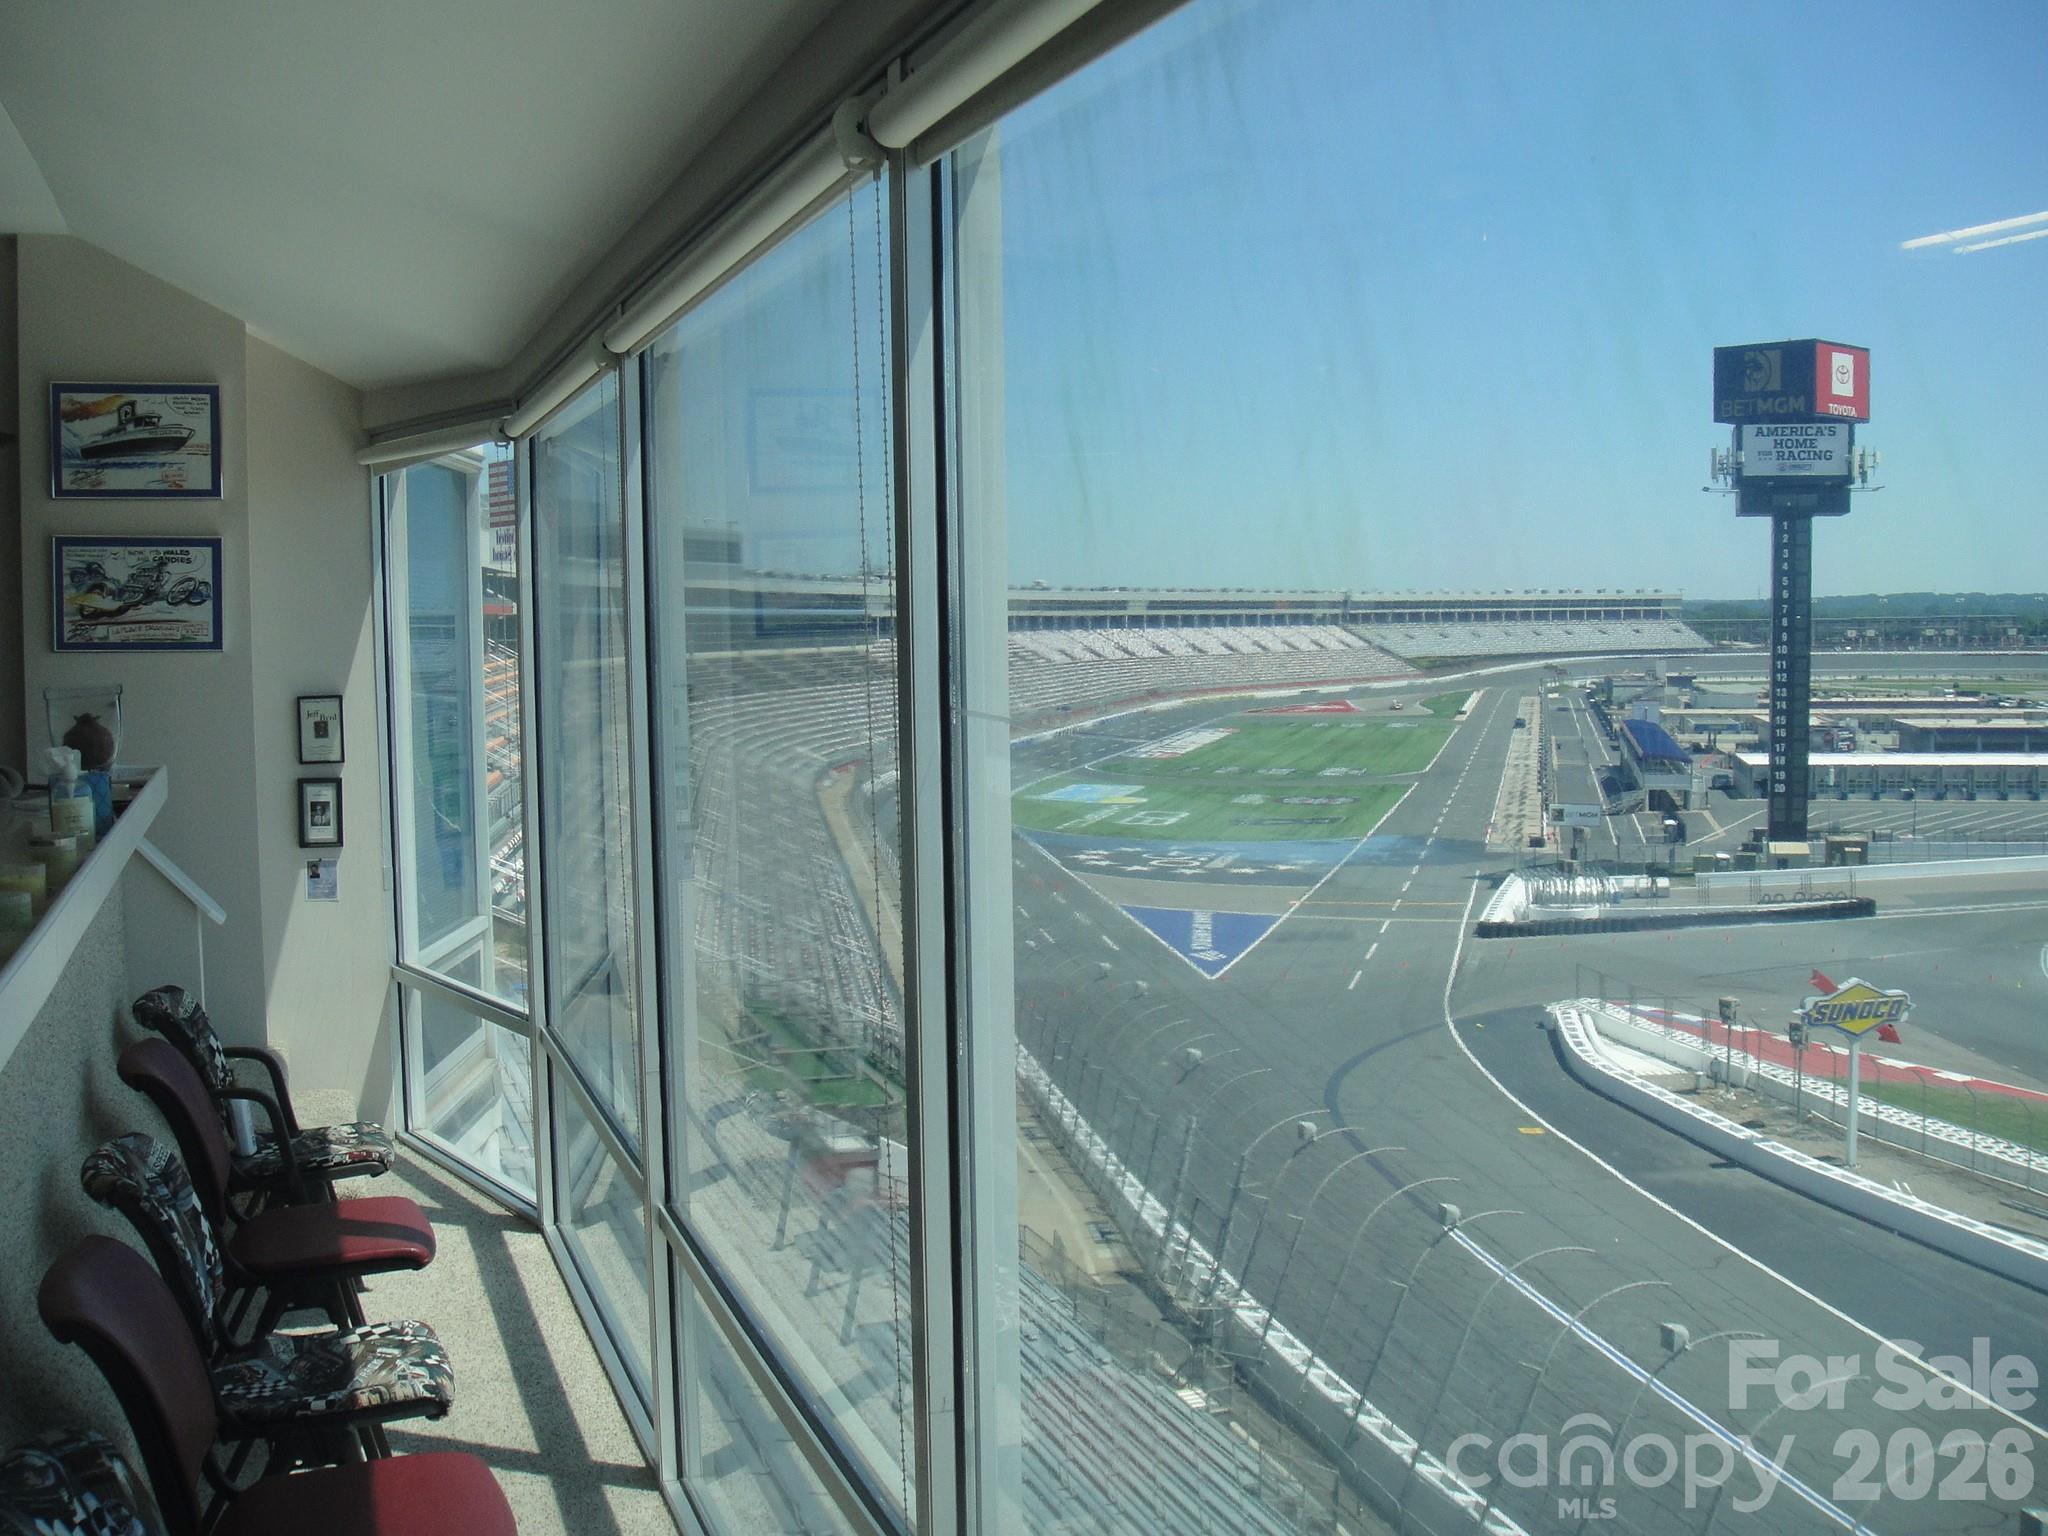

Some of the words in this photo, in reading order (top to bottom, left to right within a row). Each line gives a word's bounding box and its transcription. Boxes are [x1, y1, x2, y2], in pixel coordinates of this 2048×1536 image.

[1721, 395, 1806, 418] BETMGM
[1828, 403, 1857, 417] TOYOTA
[1755, 426, 1836, 437] AMERICA'S
[1773, 438, 1818, 449] HOME
[1775, 450, 1833, 461] RACING
[1782, 521, 1788, 530] 1
[1782, 534, 1789, 543] 2
[1782, 549, 1789, 558] 3
[1782, 562, 1788, 570] 4
[1782, 576, 1789, 586] 5
[1782, 590, 1789, 599] 6
[1781, 604, 1788, 613] 7
[1781, 632, 1788, 642] 9
[1777, 645, 1788, 655] 10
[1776, 661, 1786, 669] 11
[1776, 673, 1787, 682] 12
[1775, 715, 1786, 725] 15
[1775, 728, 1786, 738] 16
[1775, 743, 1786, 752] 17
[1774, 770, 1786, 780] 19
[1812, 998, 1905, 1022] SUNOCO
